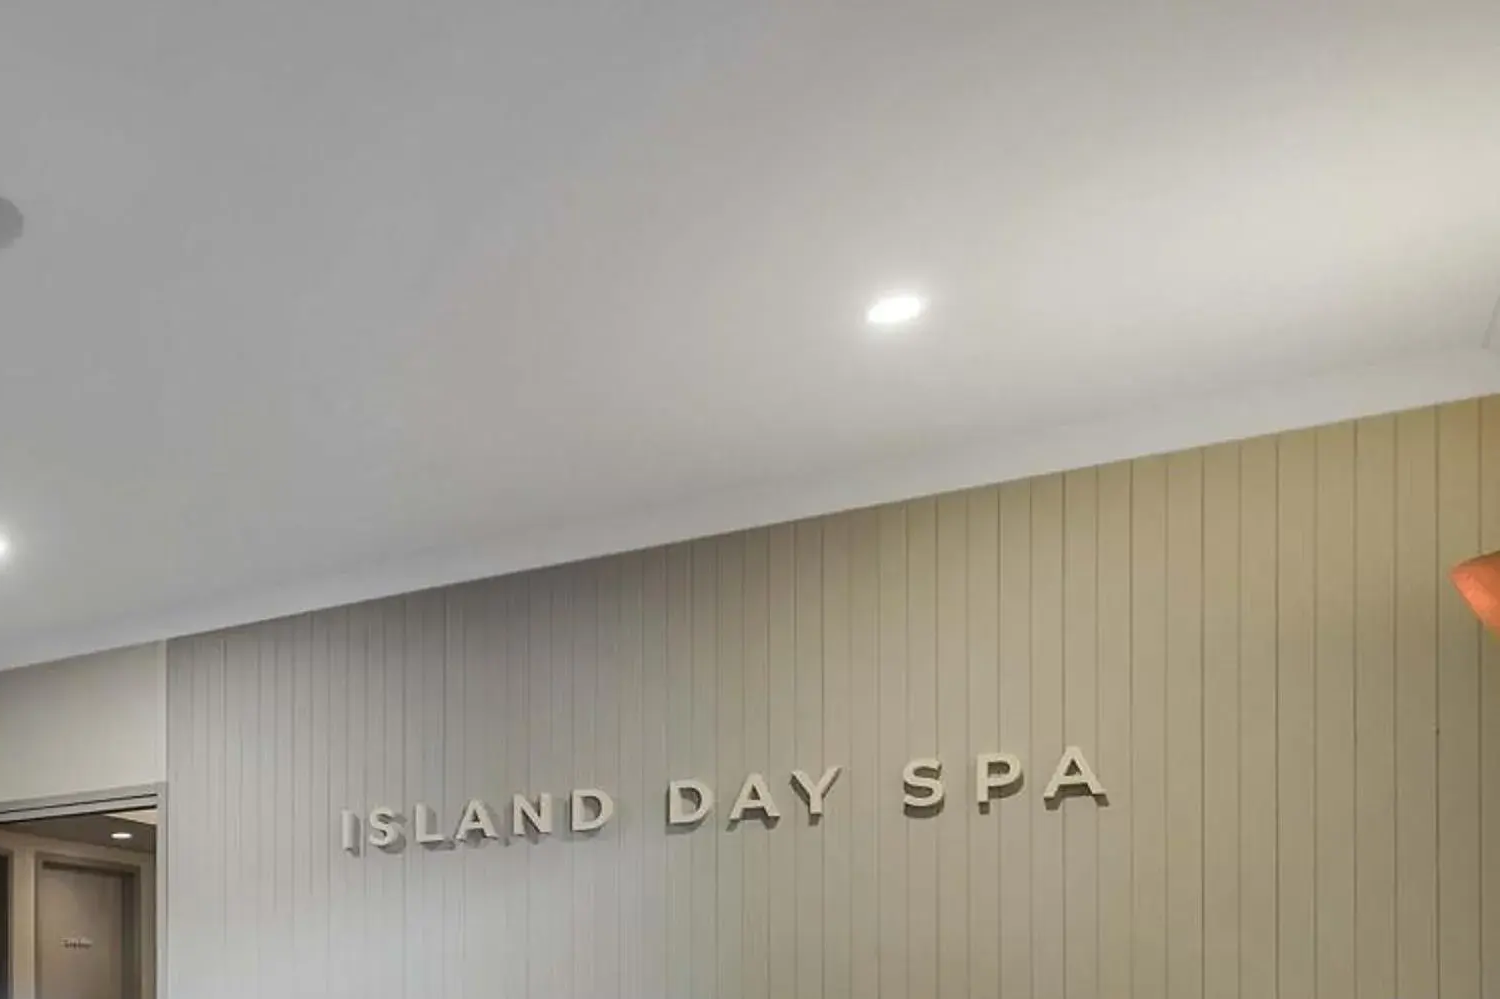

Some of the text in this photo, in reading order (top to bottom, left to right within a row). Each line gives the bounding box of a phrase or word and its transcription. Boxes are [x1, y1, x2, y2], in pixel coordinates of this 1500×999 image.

[341, 744, 1108, 852] ISLAND DAY SPA
